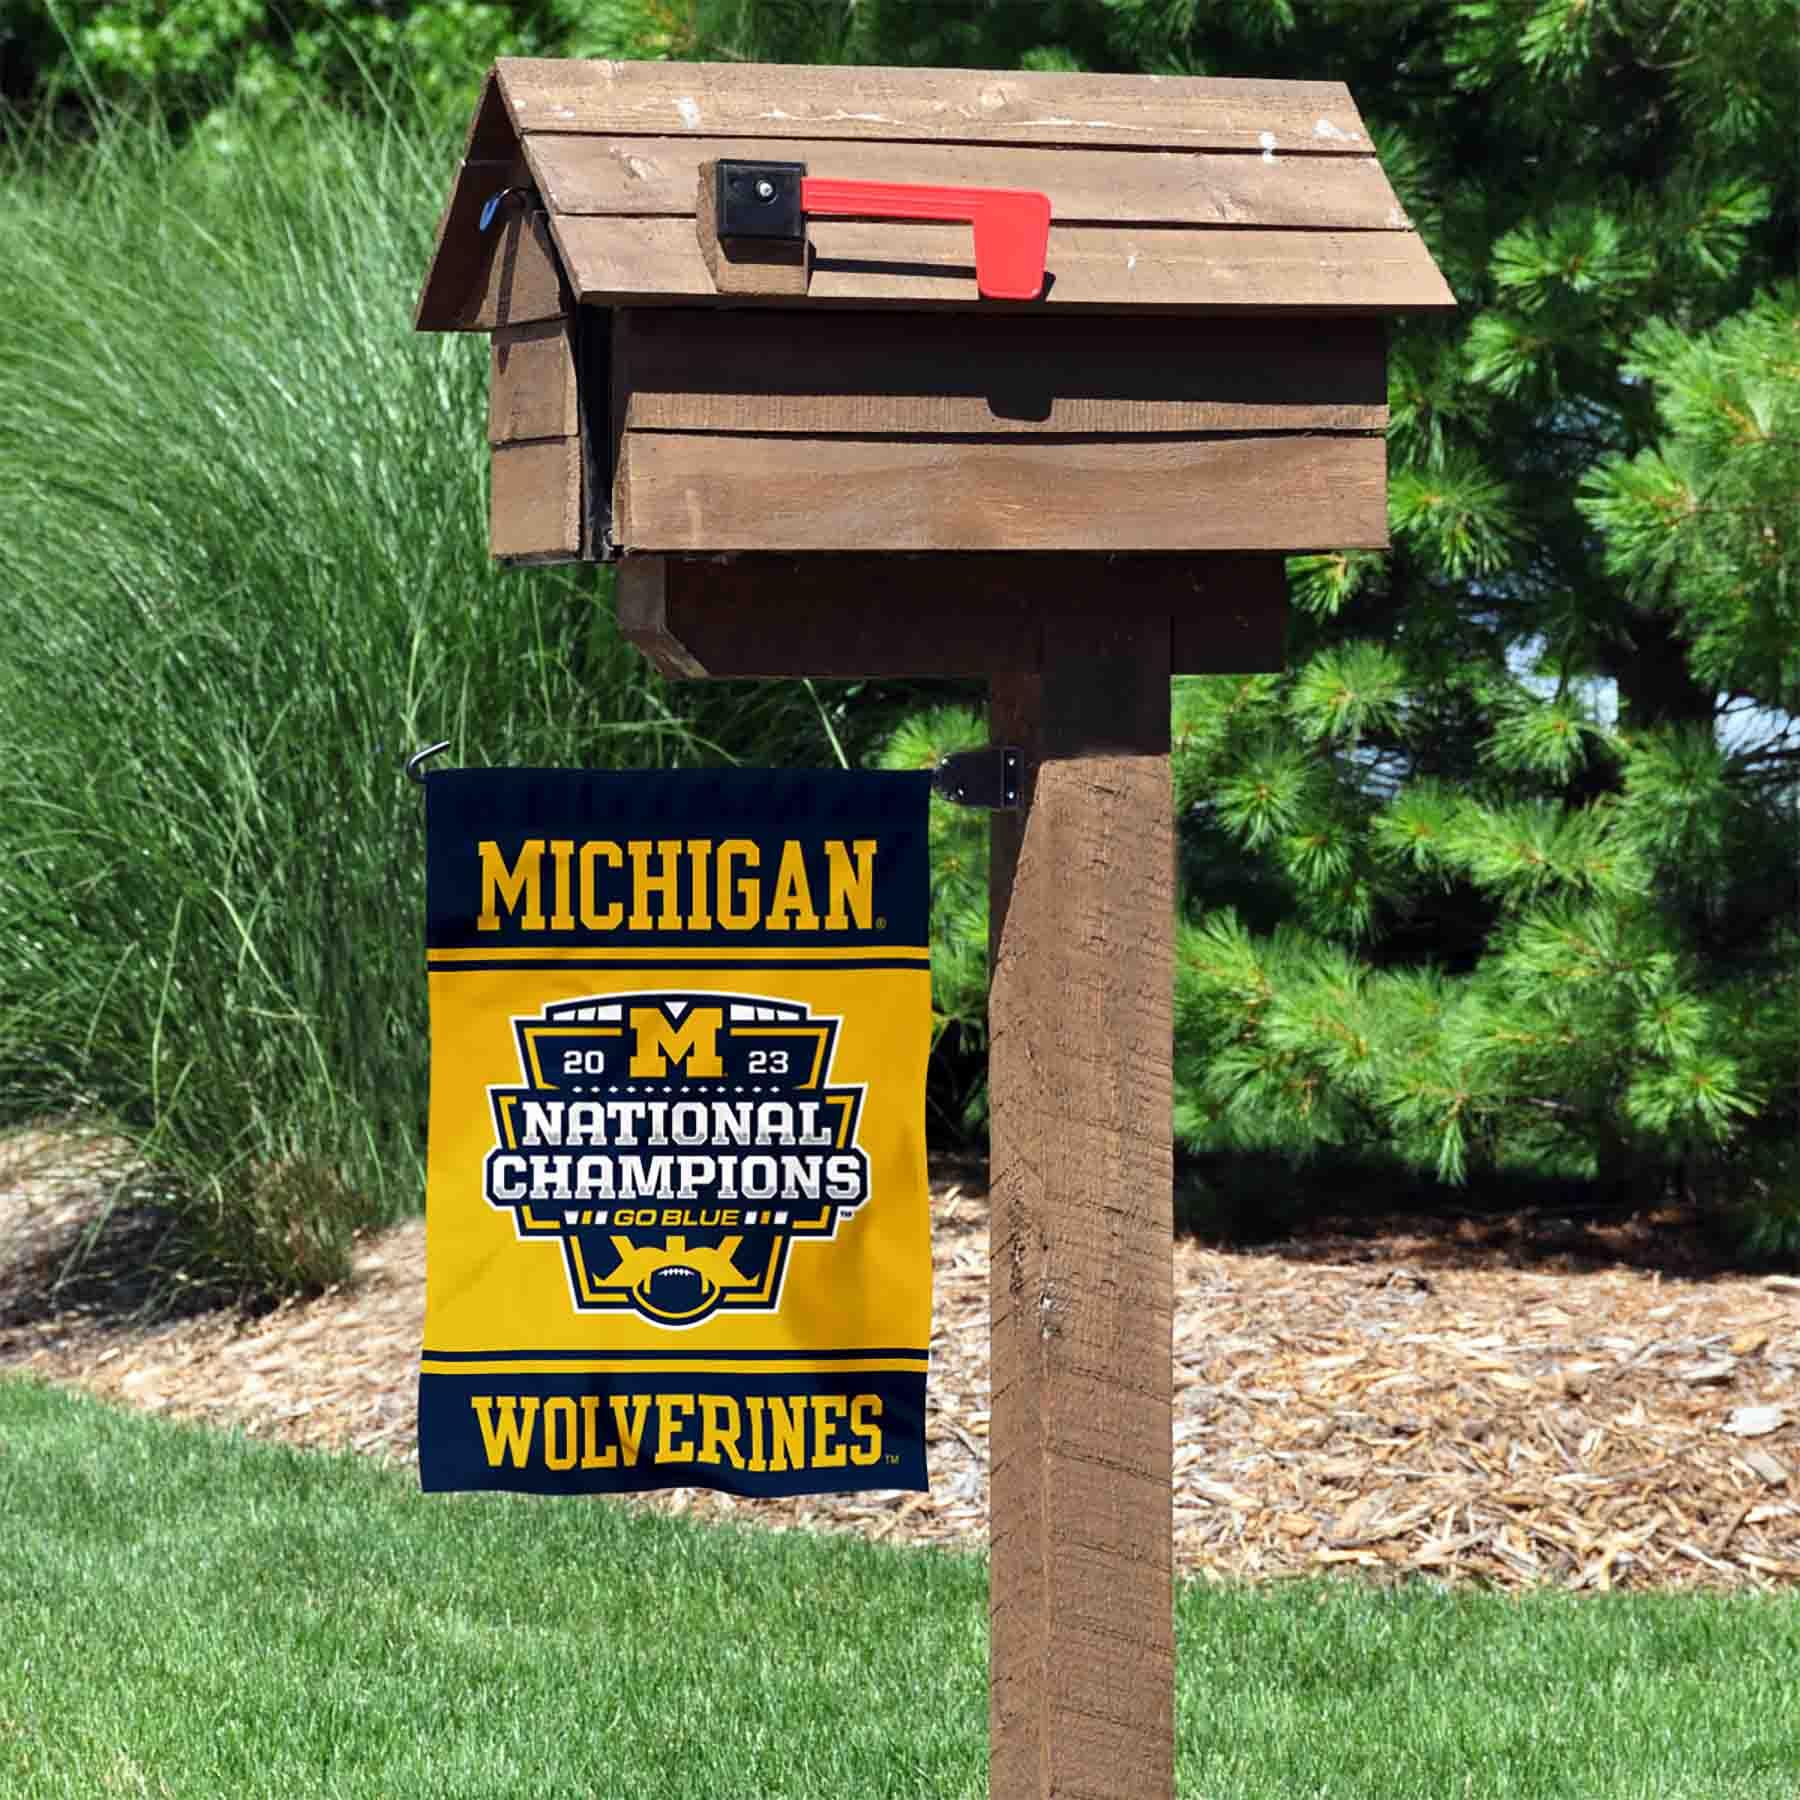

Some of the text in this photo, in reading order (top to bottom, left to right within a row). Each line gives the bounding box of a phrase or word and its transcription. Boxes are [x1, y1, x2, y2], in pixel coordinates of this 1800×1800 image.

[478, 839, 877, 930] MICHIGAN
[563, 1007, 789, 1078] 20 M 23
[522, 1101, 832, 1146] NATIONAL
[492, 1155, 862, 1200] CHAMPIONS
[613, 1209, 740, 1227] GO BLUE
[471, 1393, 883, 1472] WOLVERINES
